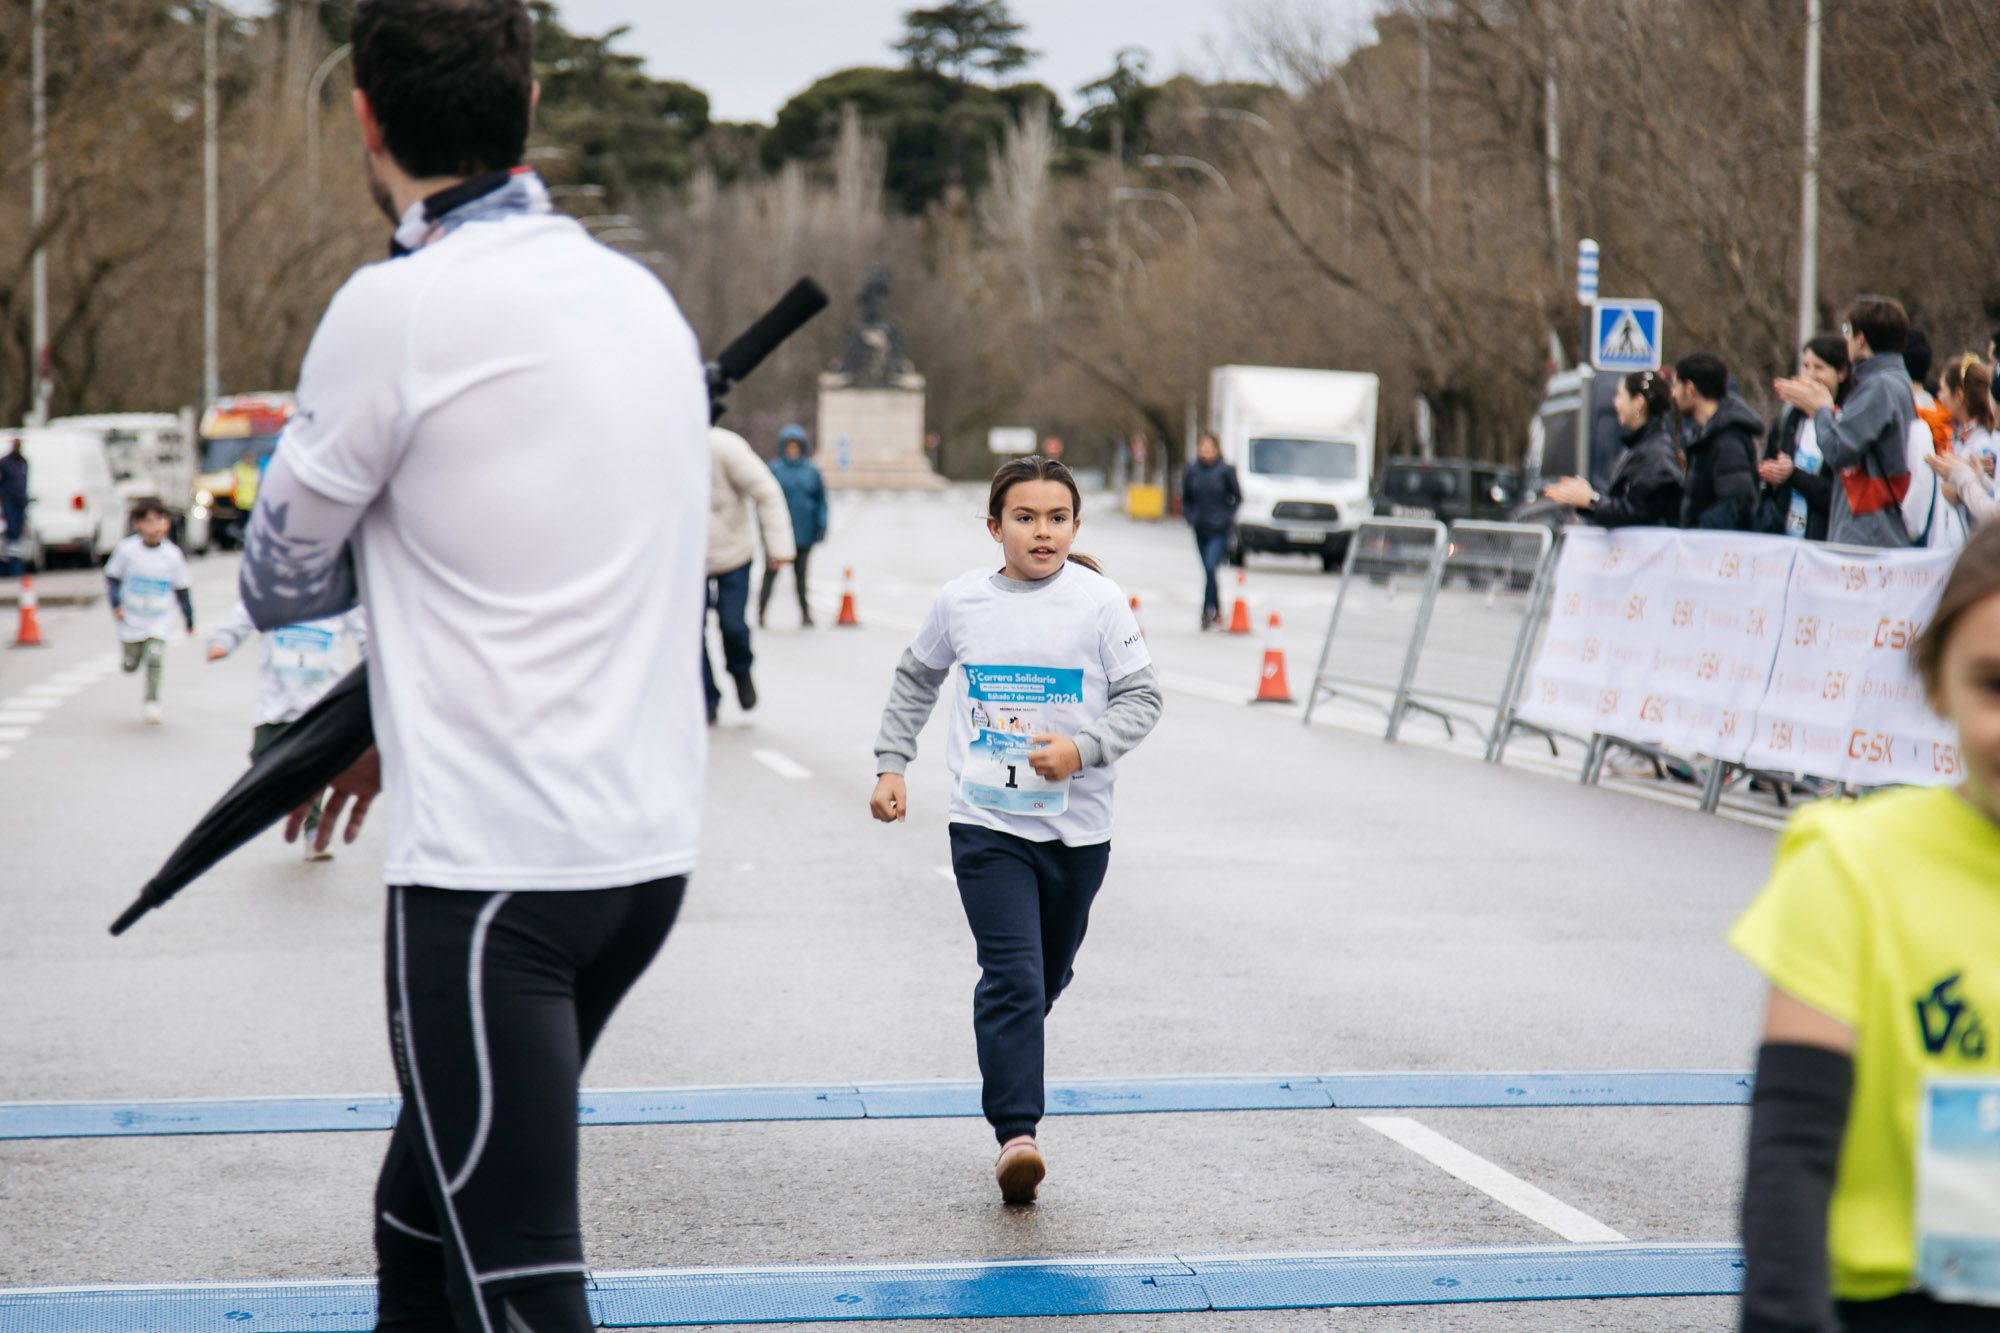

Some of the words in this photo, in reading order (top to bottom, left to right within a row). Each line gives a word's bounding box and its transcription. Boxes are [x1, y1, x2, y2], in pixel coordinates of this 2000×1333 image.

[977, 672, 1013, 683] Carrera
[1015, 672, 1056, 684] Solidaria
[1016, 693, 1025, 701] de
[1046, 693, 1079, 704] 2026
[1005, 765, 1018, 789] 1
